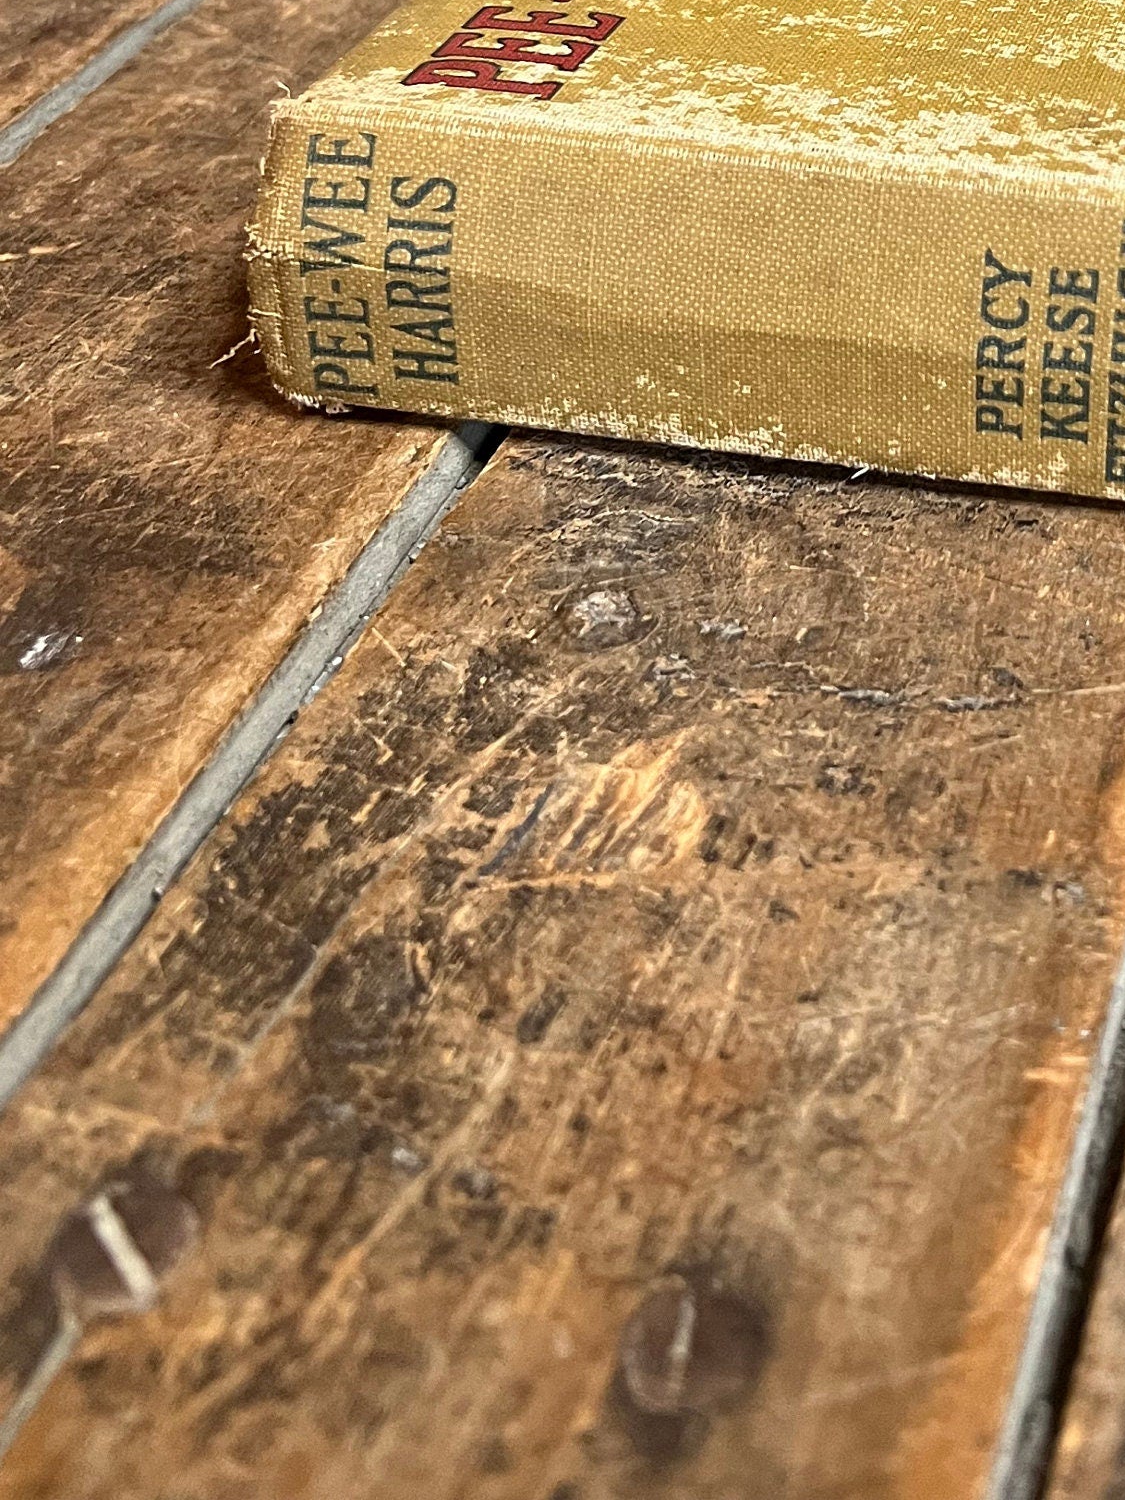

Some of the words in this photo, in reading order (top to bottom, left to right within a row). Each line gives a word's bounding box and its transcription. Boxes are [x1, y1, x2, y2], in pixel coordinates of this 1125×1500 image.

[299, 131, 378, 397] PEE-WEE
[384, 175, 459, 384] HARRIS
[976, 247, 1033, 441] PERCY
[1040, 266, 1099, 445] KEESE
